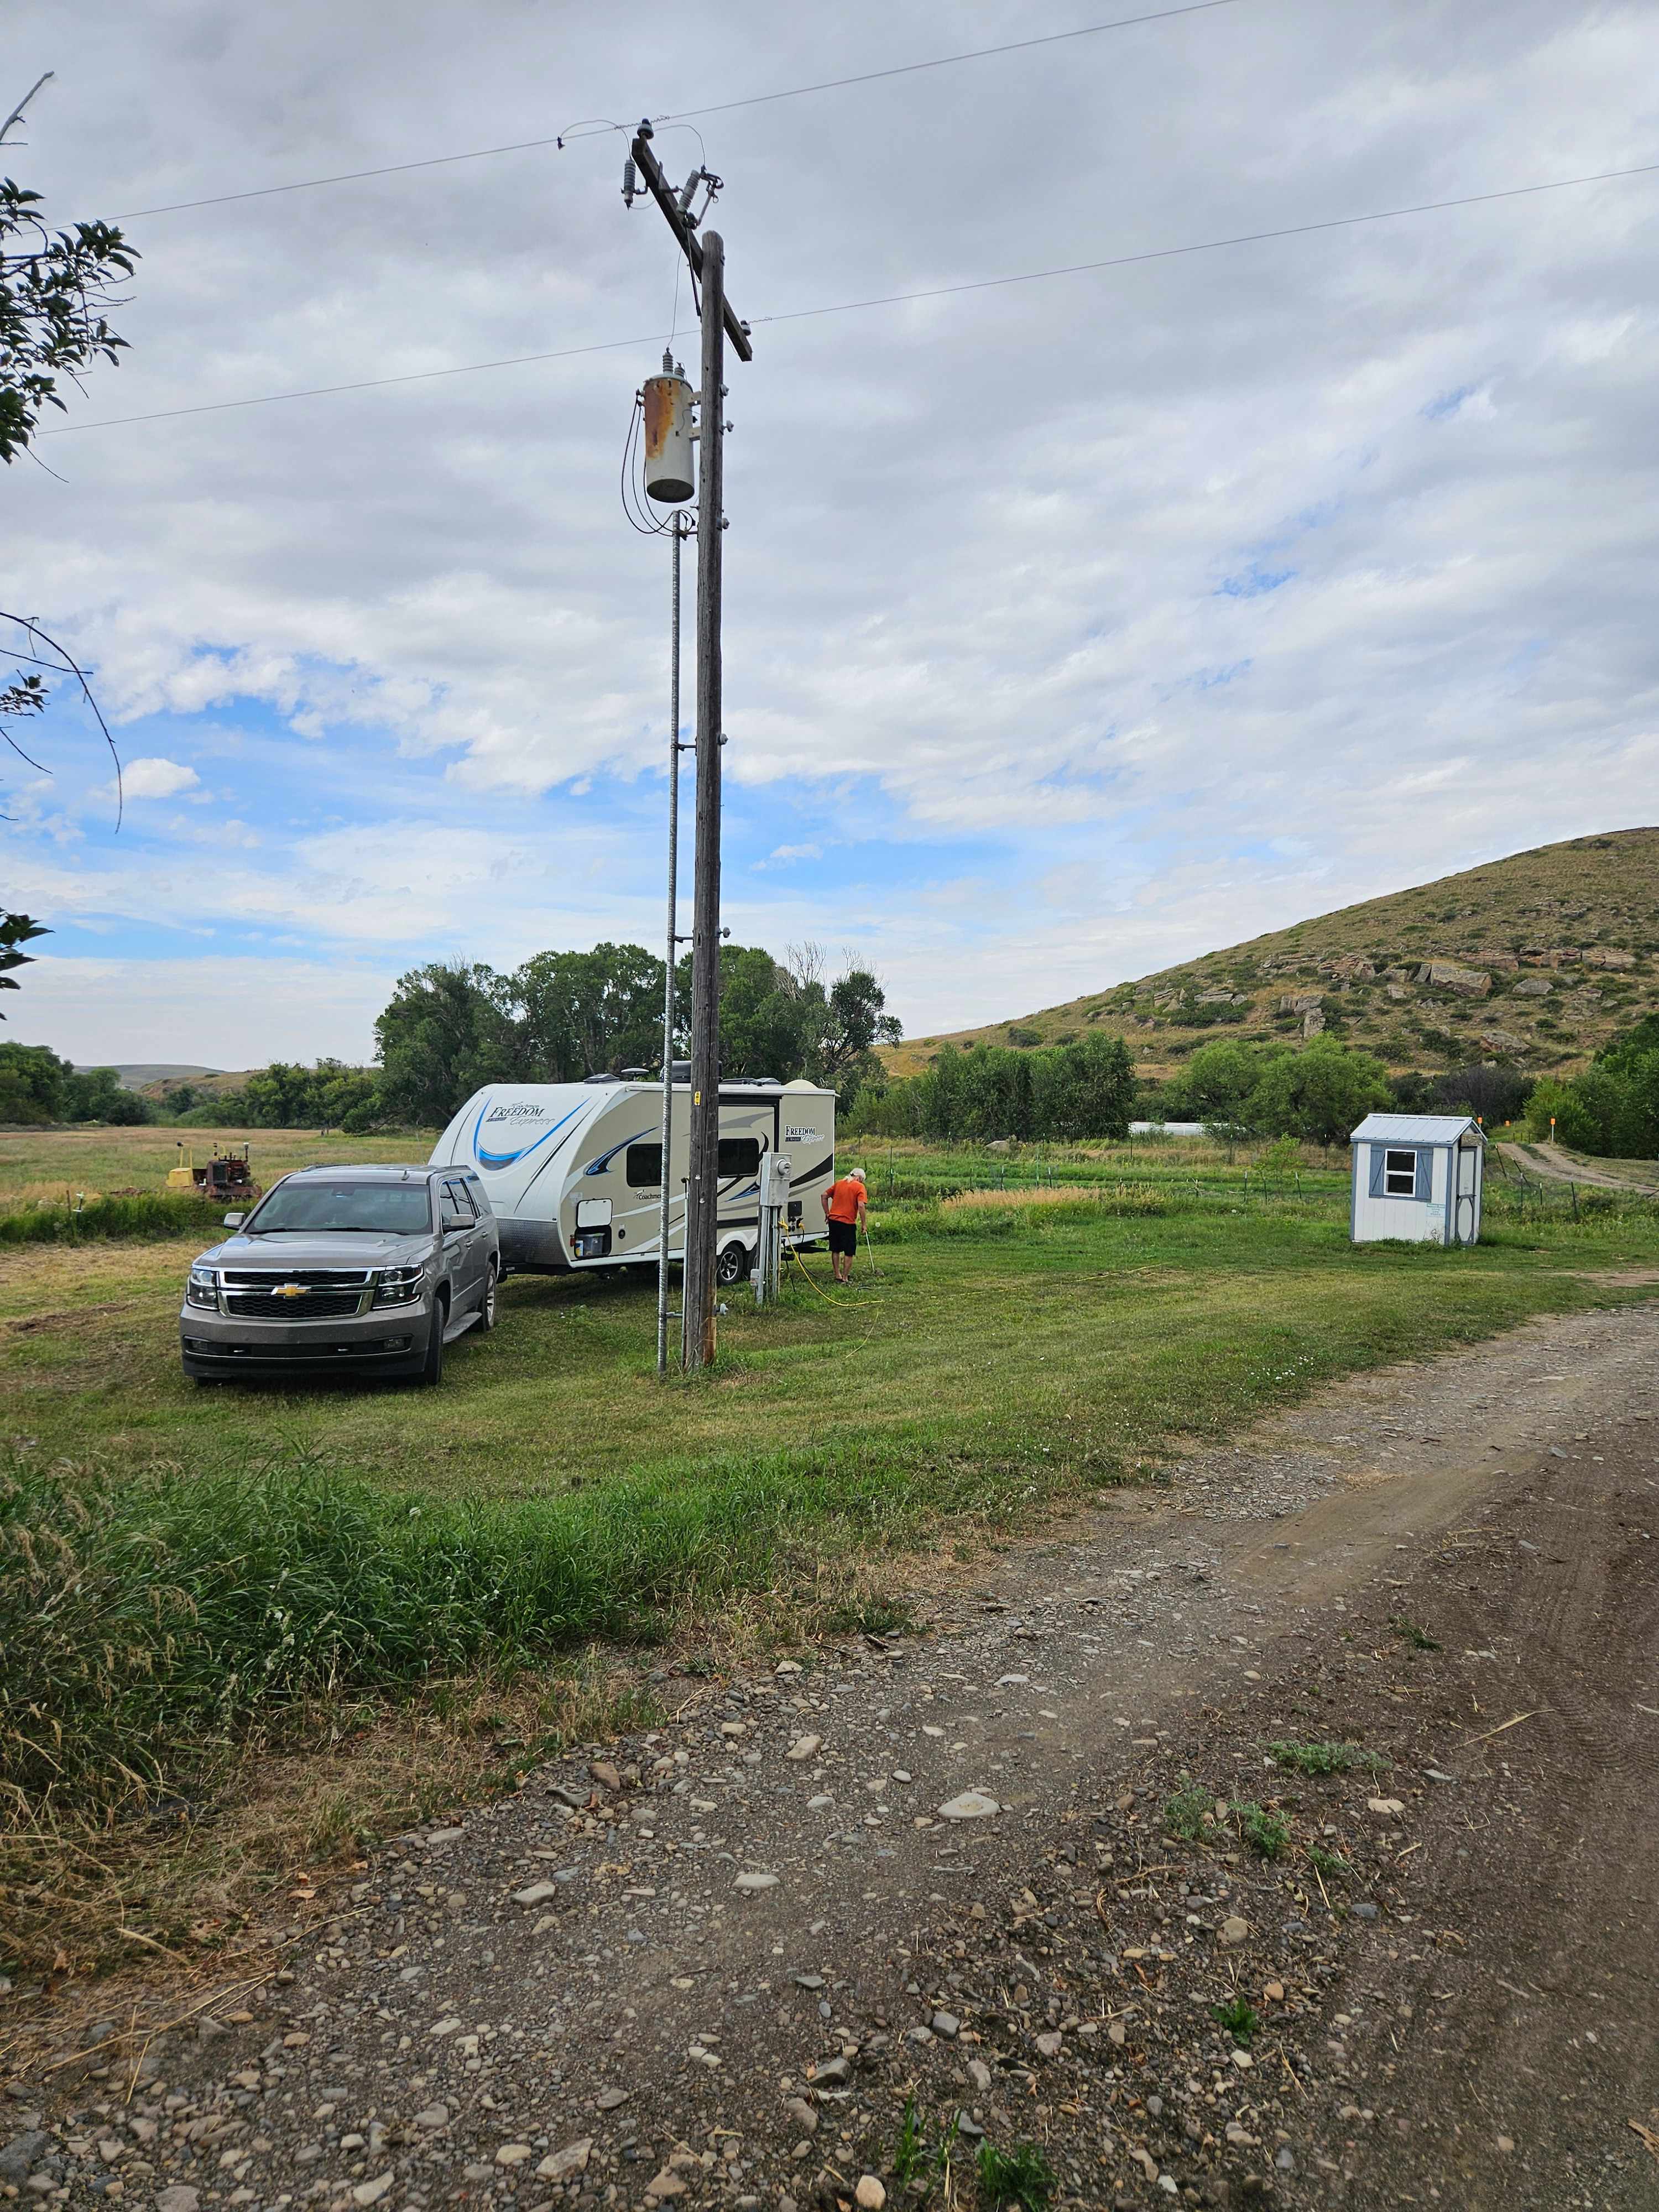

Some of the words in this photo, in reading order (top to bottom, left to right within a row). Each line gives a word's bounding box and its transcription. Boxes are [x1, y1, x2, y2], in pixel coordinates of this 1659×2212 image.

[489, 1107, 545, 1117] FREEDOM
[510, 1115, 555, 1126] Express
[785, 1125, 815, 1135] FREEDOM
